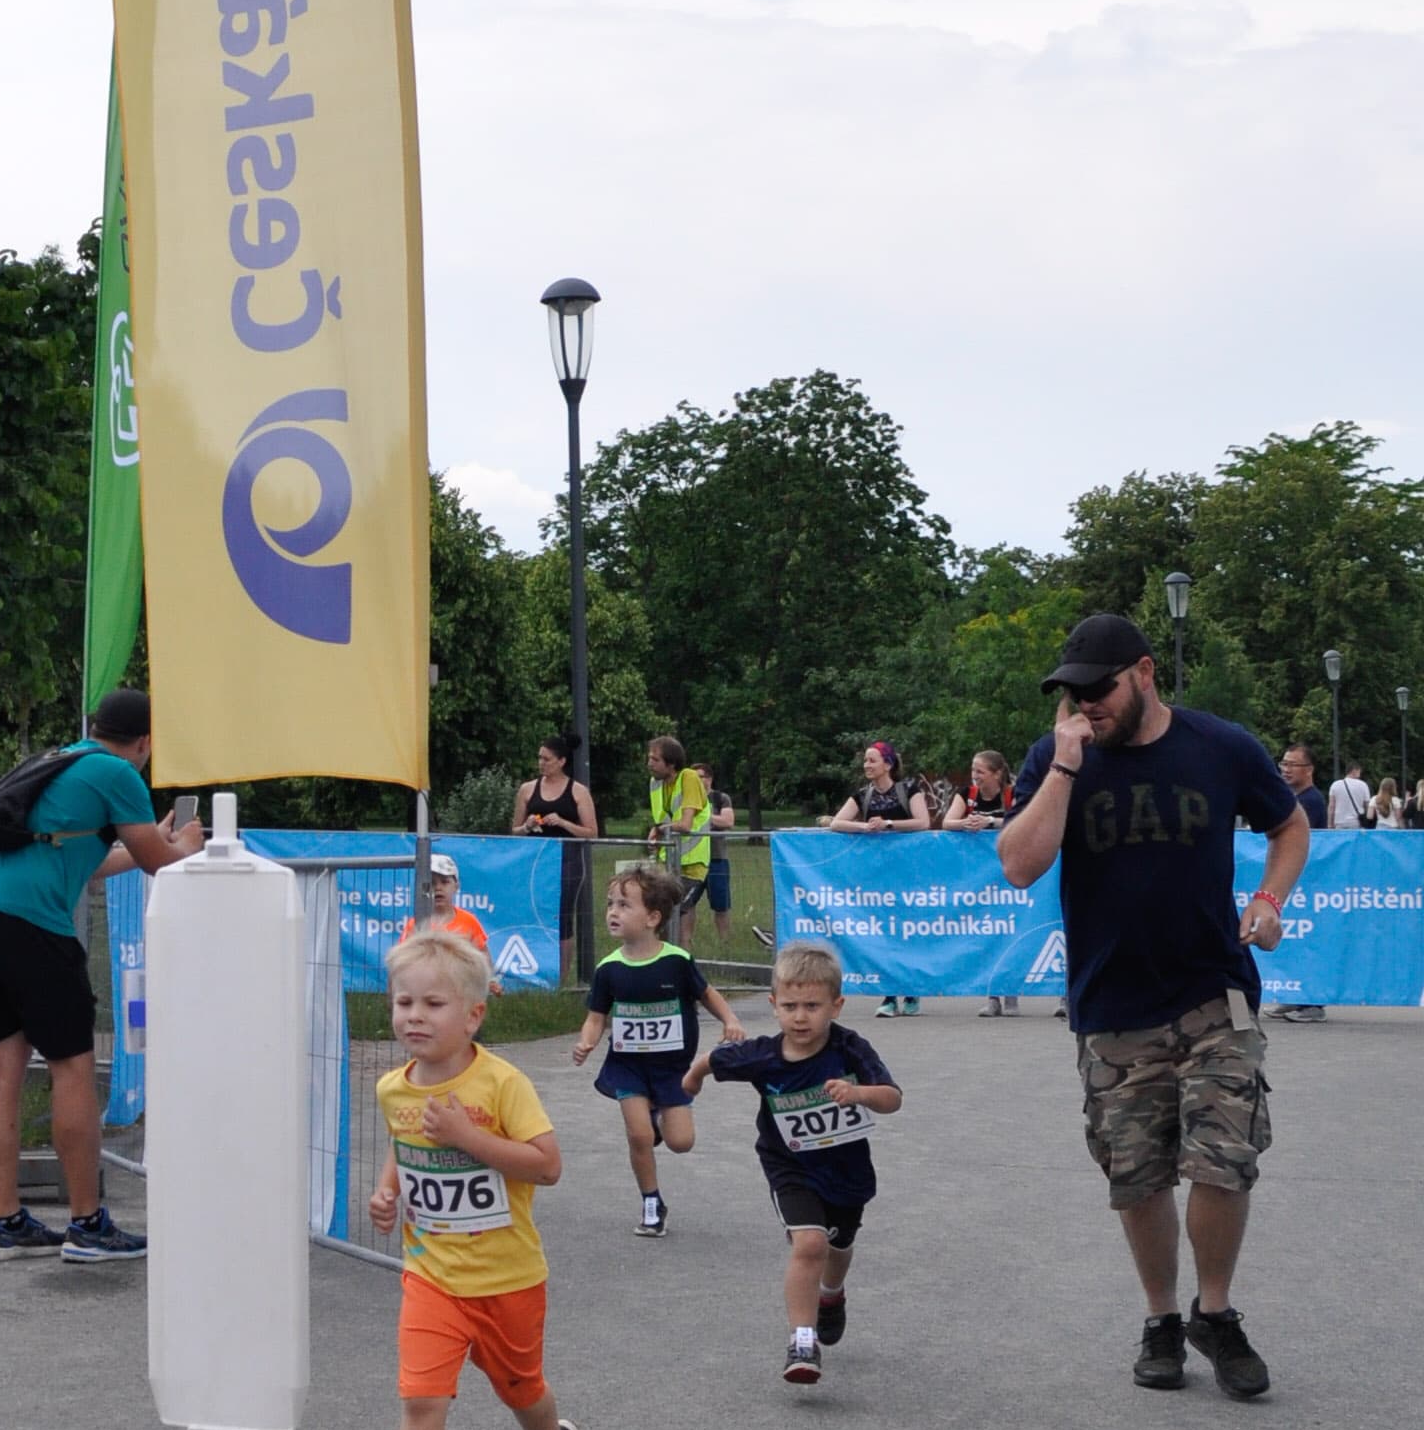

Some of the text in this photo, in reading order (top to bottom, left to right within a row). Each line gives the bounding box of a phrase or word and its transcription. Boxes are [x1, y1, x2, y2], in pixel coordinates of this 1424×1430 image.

[1083, 783, 1209, 853] GAP
[367, 886, 411, 907] vaši
[793, 885, 1035, 911] Pojistíme vaši rodinu,
[1314, 886, 1423, 913] pojištění
[795, 913, 1016, 940] majetek i podnikání
[1281, 918, 1314, 940] ZP
[622, 1019, 673, 1041] 2137
[784, 1103, 863, 1138] 2073
[405, 1173, 495, 1213] 2076
